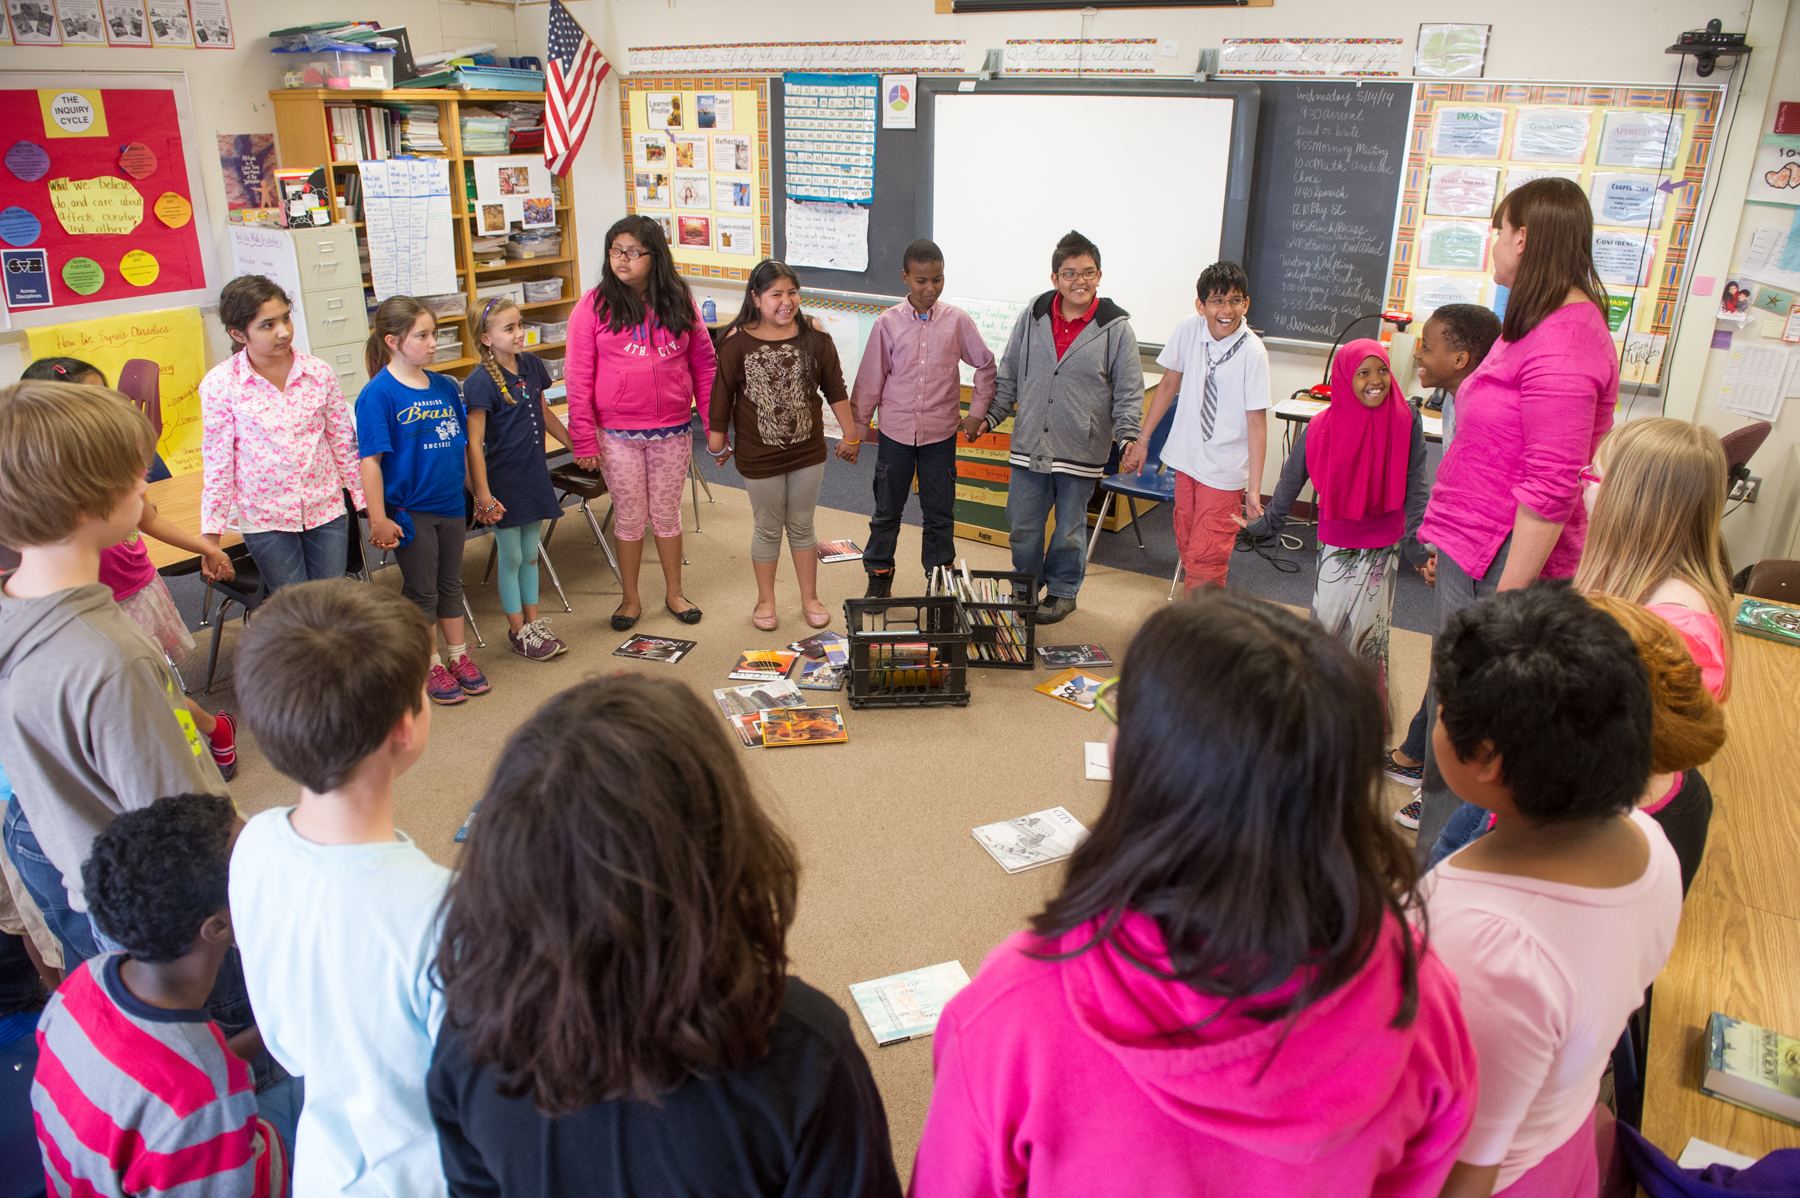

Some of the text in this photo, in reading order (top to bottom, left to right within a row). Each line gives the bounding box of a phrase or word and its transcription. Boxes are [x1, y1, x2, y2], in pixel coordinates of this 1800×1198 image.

[61, 96, 79, 104] THE
[1296, 86, 1395, 107] Wednesday 5/14/14
[649, 100, 672, 108] Learner
[55, 106, 89, 115] INQUIRY
[651, 107, 670, 115] Profile
[60, 116, 90, 125] CYCLE
[1614, 128, 1668, 136] APPRECIAO
[639, 135, 659, 145] Caring
[715, 138, 745, 146] Reflective
[48, 178, 68, 191] What
[73, 182, 91, 190] we
[71, 195, 88, 207] and
[93, 199, 116, 207] care
[120, 196, 143, 207] about
[59, 212, 142, 222] affects ourselves
[681, 217, 706, 226] Thinkers
[66, 223, 129, 233] and others
[718, 223, 751, 231] Open-minded
[56, 334, 75, 349] How
[623, 342, 649, 356] ATH.
[413, 399, 443, 407] PARADISE
[978, 531, 992, 541] Kaplan
[1053, 809, 1075, 826] CITY
